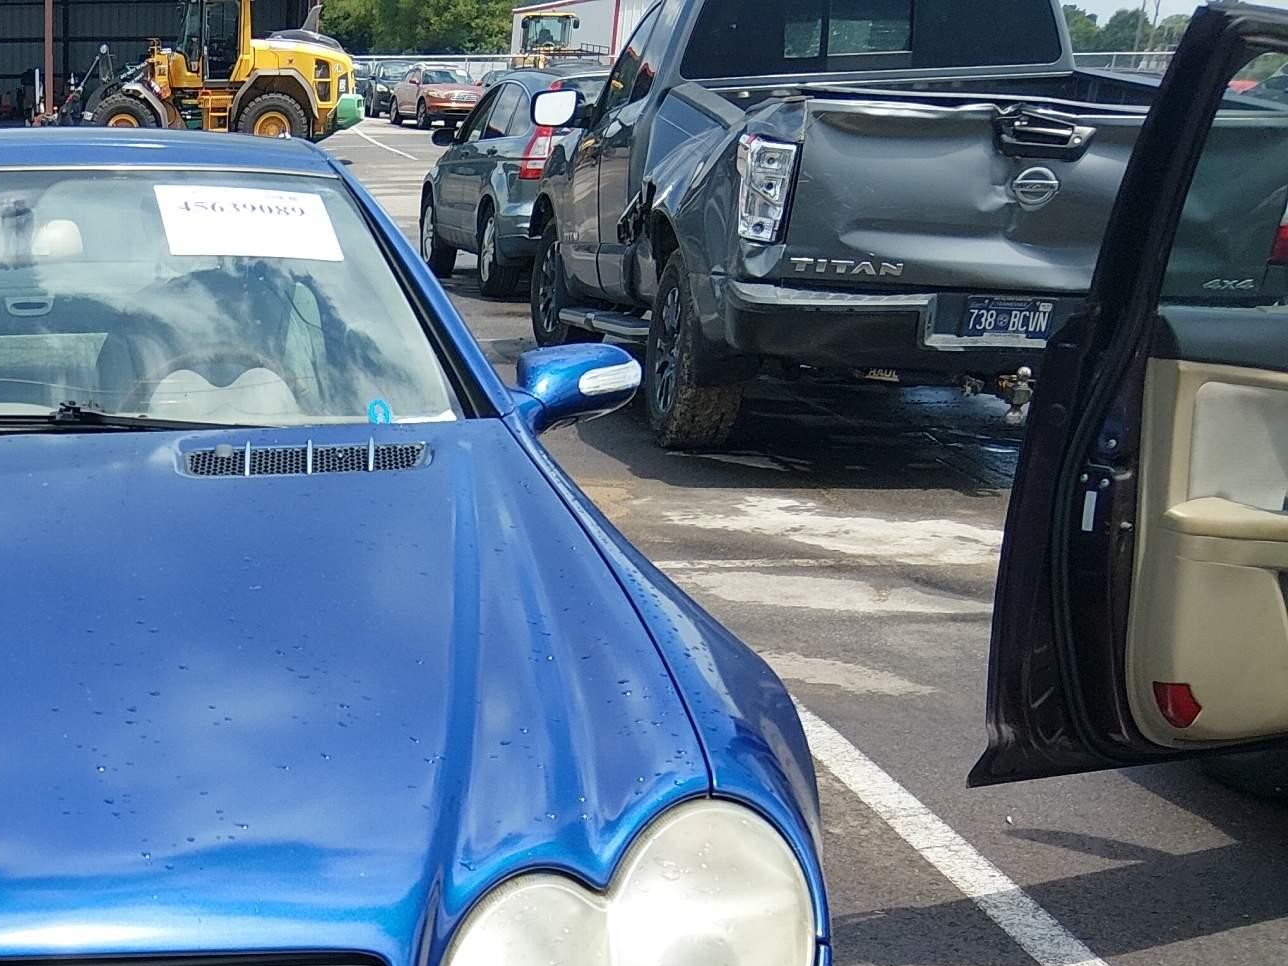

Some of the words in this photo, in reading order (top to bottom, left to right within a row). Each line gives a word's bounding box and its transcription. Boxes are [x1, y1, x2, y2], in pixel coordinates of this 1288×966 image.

[790, 257, 904, 277] TITAN
[968, 309, 997, 330] 738
[1008, 310, 1049, 332] BCVN
